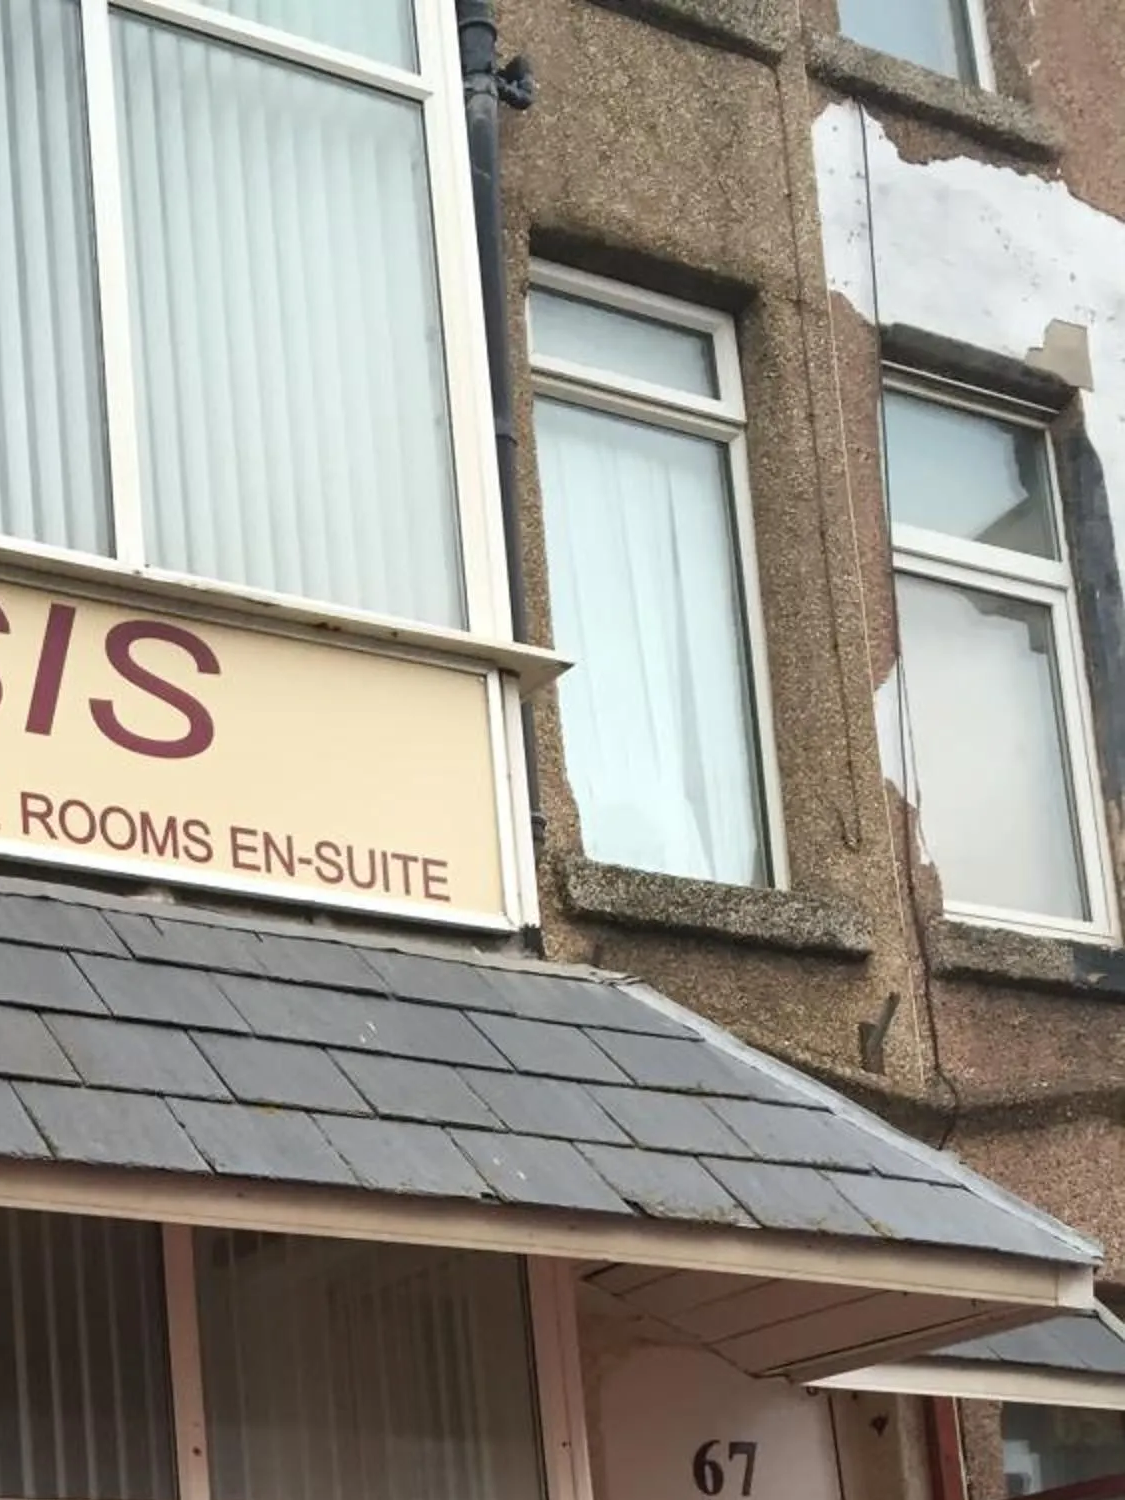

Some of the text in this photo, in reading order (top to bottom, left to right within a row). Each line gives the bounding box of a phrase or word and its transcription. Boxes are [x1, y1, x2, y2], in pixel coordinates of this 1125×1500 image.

[20, 790, 213, 863] ROOMS
[230, 825, 452, 902] EN-SUITE
[692, 1439, 757, 1497] 67
